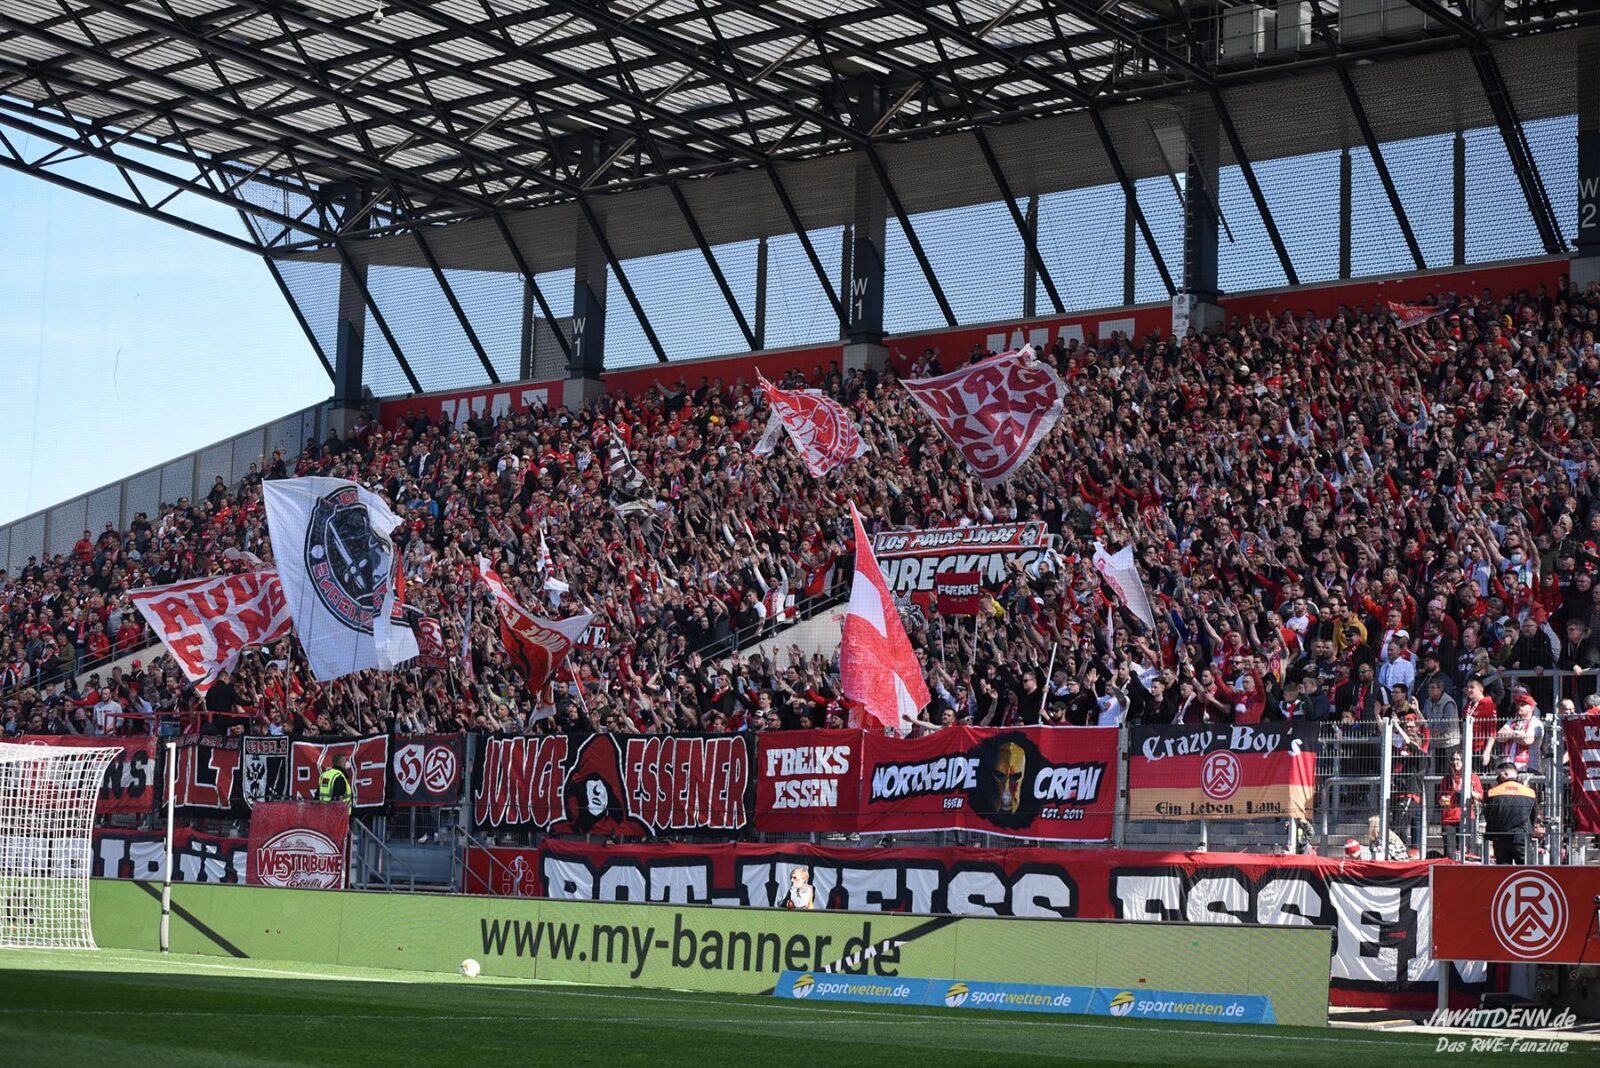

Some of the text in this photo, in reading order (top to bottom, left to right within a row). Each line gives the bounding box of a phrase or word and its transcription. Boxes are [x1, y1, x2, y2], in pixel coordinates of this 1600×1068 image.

[1578, 176, 1600, 200] W
[1581, 203, 1597, 229] 2
[852, 277, 868, 296] W
[855, 299, 863, 320] 1
[572, 316, 586, 334] W
[575, 337, 581, 356] 1
[877, 536, 907, 551] LOS
[474, 734, 749, 830] JUNGE ESSENER
[872, 757, 1102, 802] NORTHSIDE CREW
[772, 778, 839, 809] ESSEN
[1064, 809, 1084, 820] 2011
[1155, 801, 1182, 816] Ein
[480, 913, 900, 979] www.my-banner.de
[816, 980, 910, 999] sportwetten.de
[971, 989, 1072, 1008] sportwetten.de
[1137, 998, 1245, 1018] sportwetten.de
